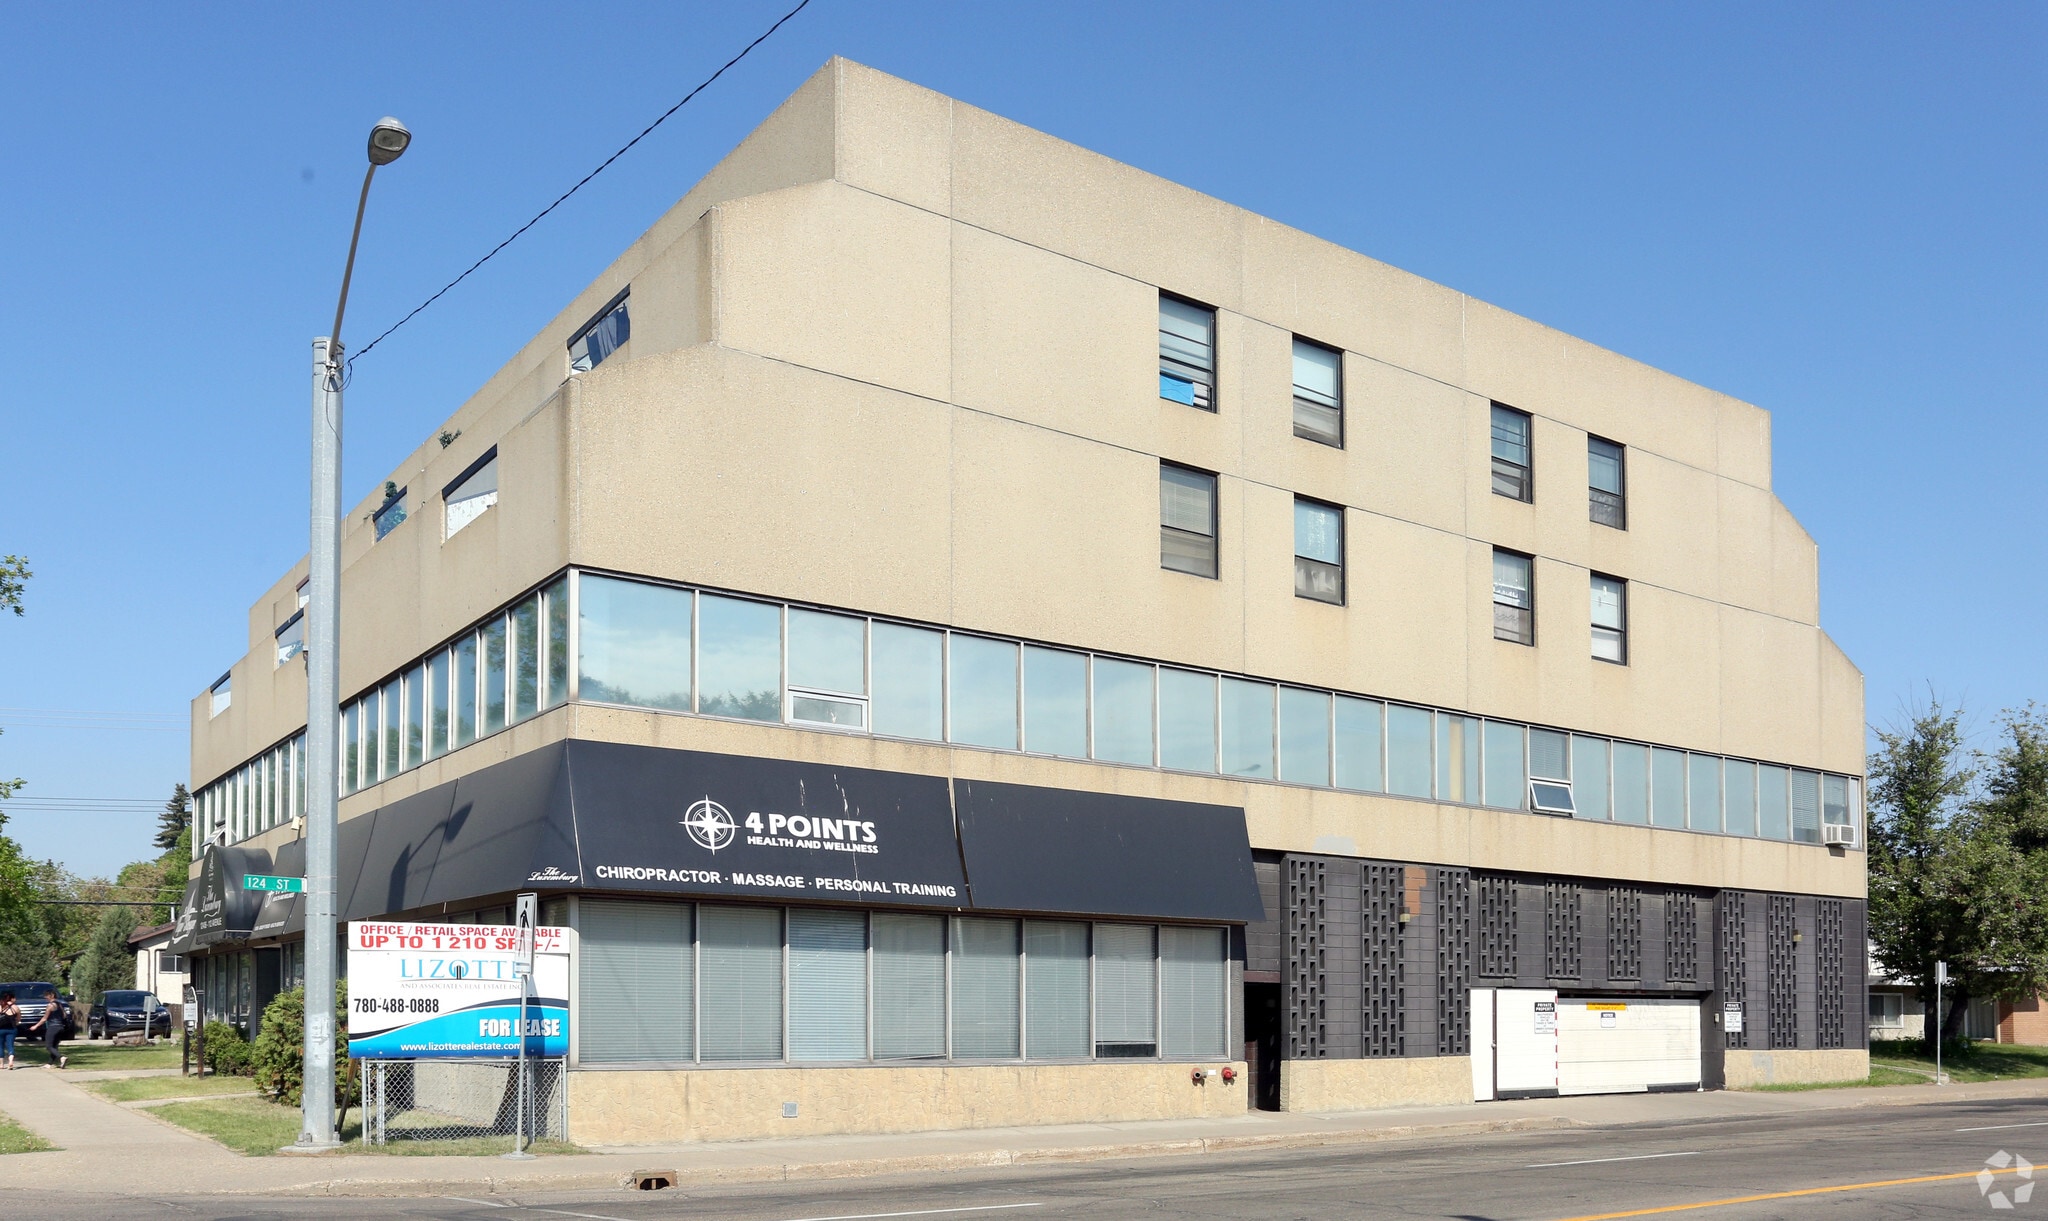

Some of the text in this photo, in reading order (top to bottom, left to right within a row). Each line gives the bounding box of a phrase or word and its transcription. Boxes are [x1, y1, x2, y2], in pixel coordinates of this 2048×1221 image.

[745, 812, 877, 843] 4 POINTS
[747, 836, 879, 854] HEALTH AND WELLNESS
[542, 866, 561, 876] The
[247, 877, 290, 890] 124 ST
[595, 865, 957, 898] CHIROPRACTOR MASSAGE PERSONAL TRAINING
[360, 925, 404, 935] OFFICE
[415, 926, 457, 936] RETAIL
[459, 927, 497, 937] SPACE
[501, 928, 561, 938] AVABLE
[360, 935, 389, 948] UP
[396, 935, 423, 949] TO
[353, 998, 439, 1013] 780-488-0888
[479, 1019, 560, 1037] FOR LEASE
[400, 1042, 520, 1051] www.lizotterealestate.com
